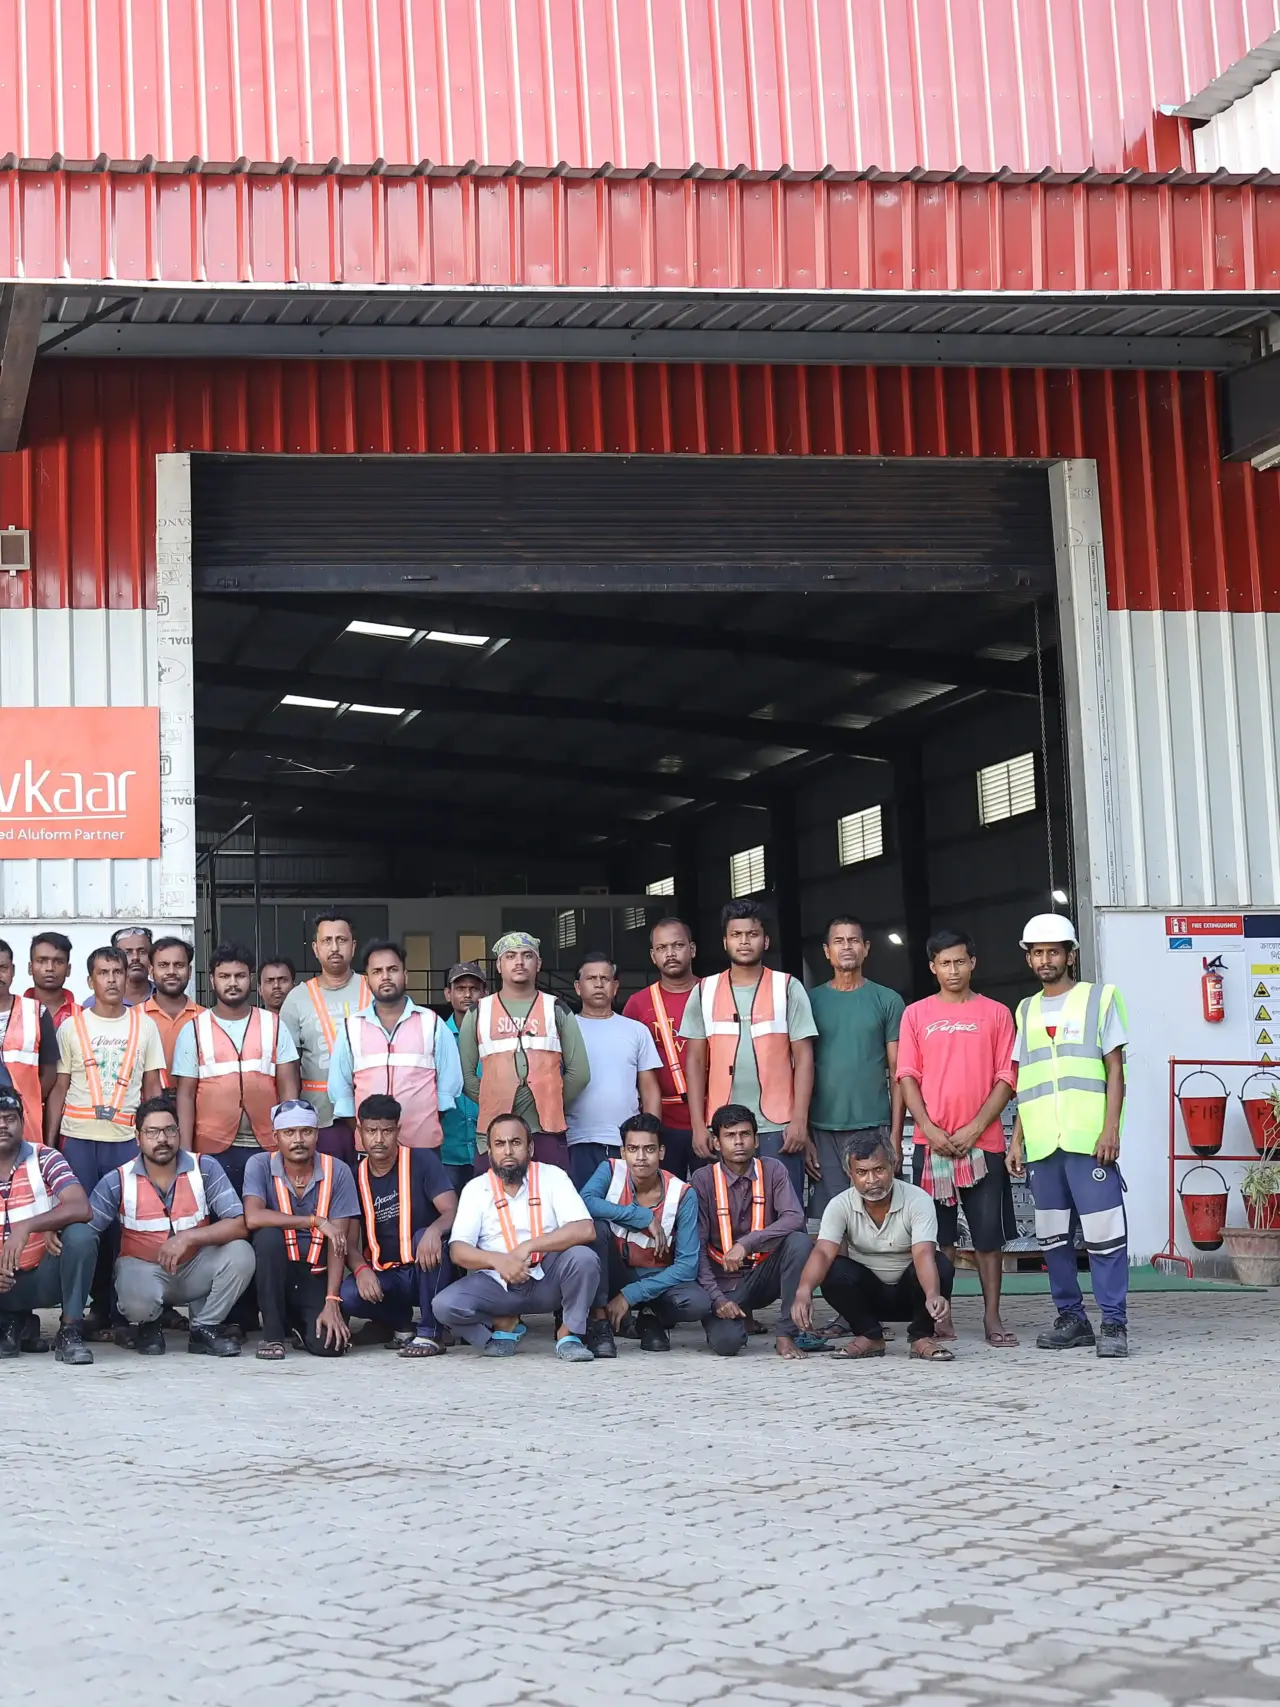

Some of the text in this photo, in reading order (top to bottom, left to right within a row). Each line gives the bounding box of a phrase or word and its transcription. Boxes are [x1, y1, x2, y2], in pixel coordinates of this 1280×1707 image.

[17, 828, 72, 840] Aluform
[74, 828, 126, 840] Partner
[925, 1019, 978, 1040] Perfect
